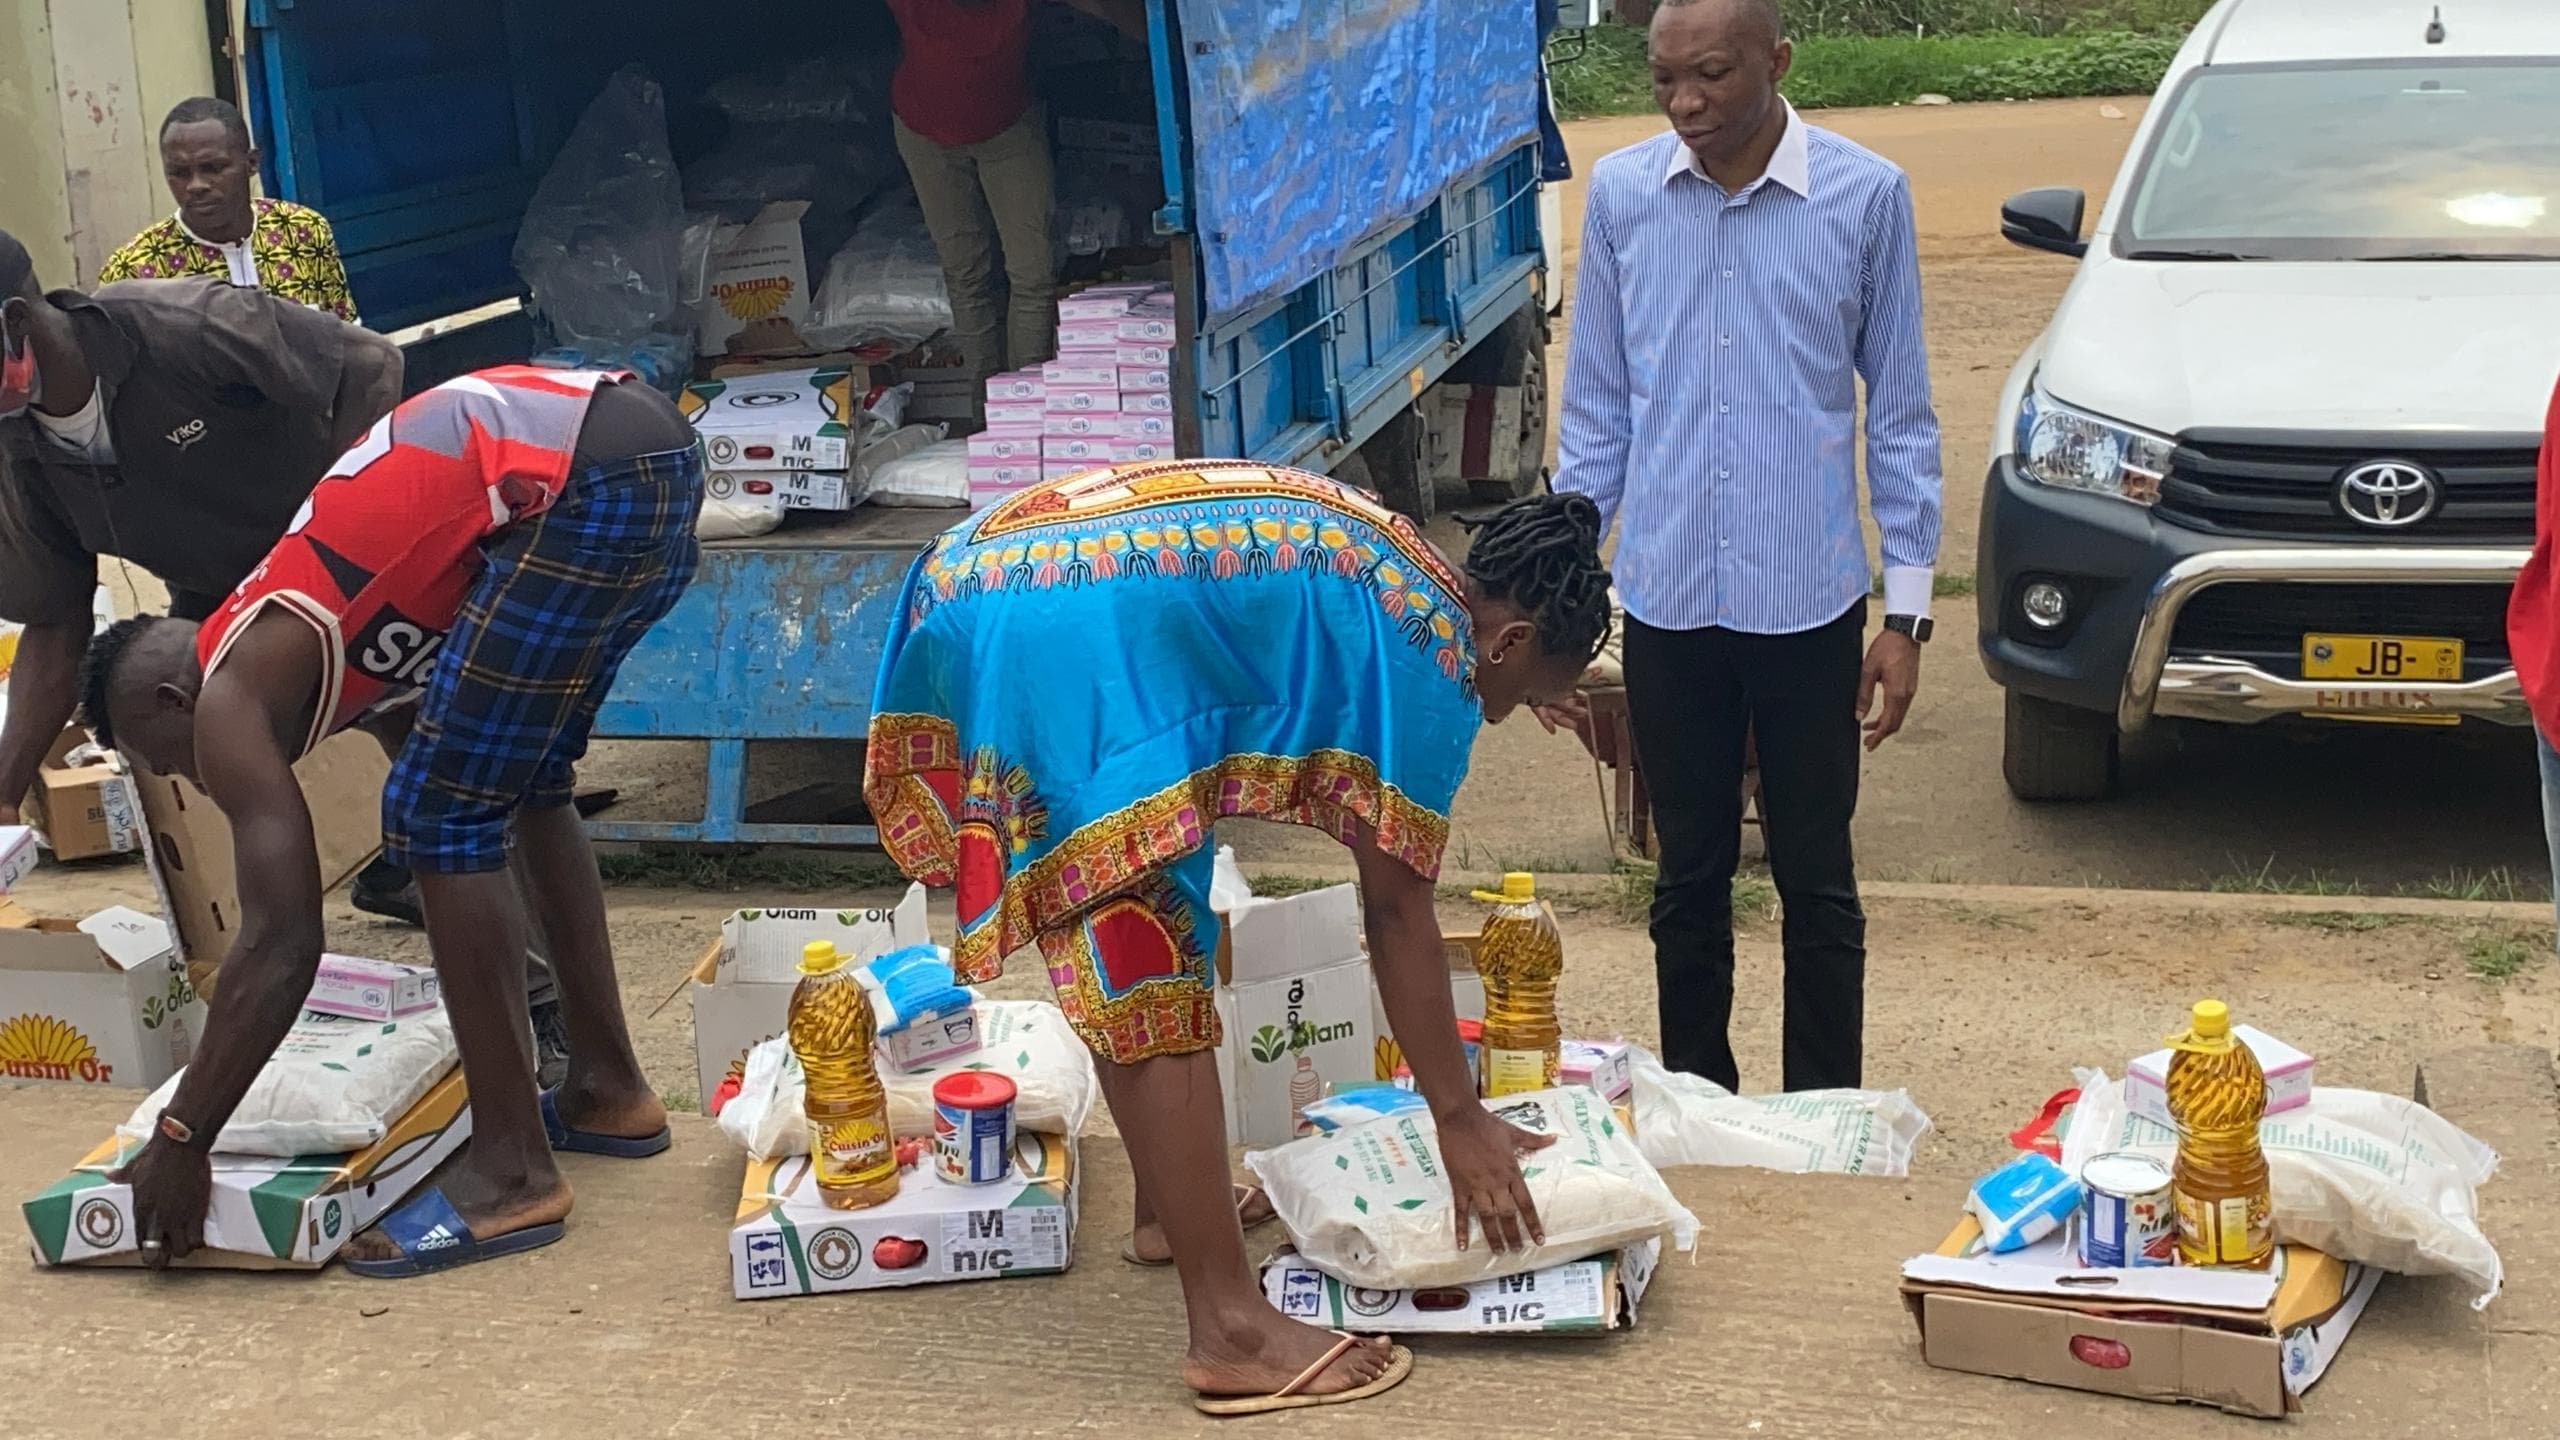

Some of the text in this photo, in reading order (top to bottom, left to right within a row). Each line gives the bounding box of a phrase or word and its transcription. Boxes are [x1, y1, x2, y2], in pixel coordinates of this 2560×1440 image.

[792, 435, 811, 451] M
[782, 456, 814, 469] n/c
[789, 473, 808, 489] M
[779, 493, 811, 506] n/c
[968, 1209, 1003, 1239] M
[953, 1249, 1013, 1272] n/c
[1499, 1271, 1535, 1294] M
[1482, 1302, 1545, 1324] n/c
